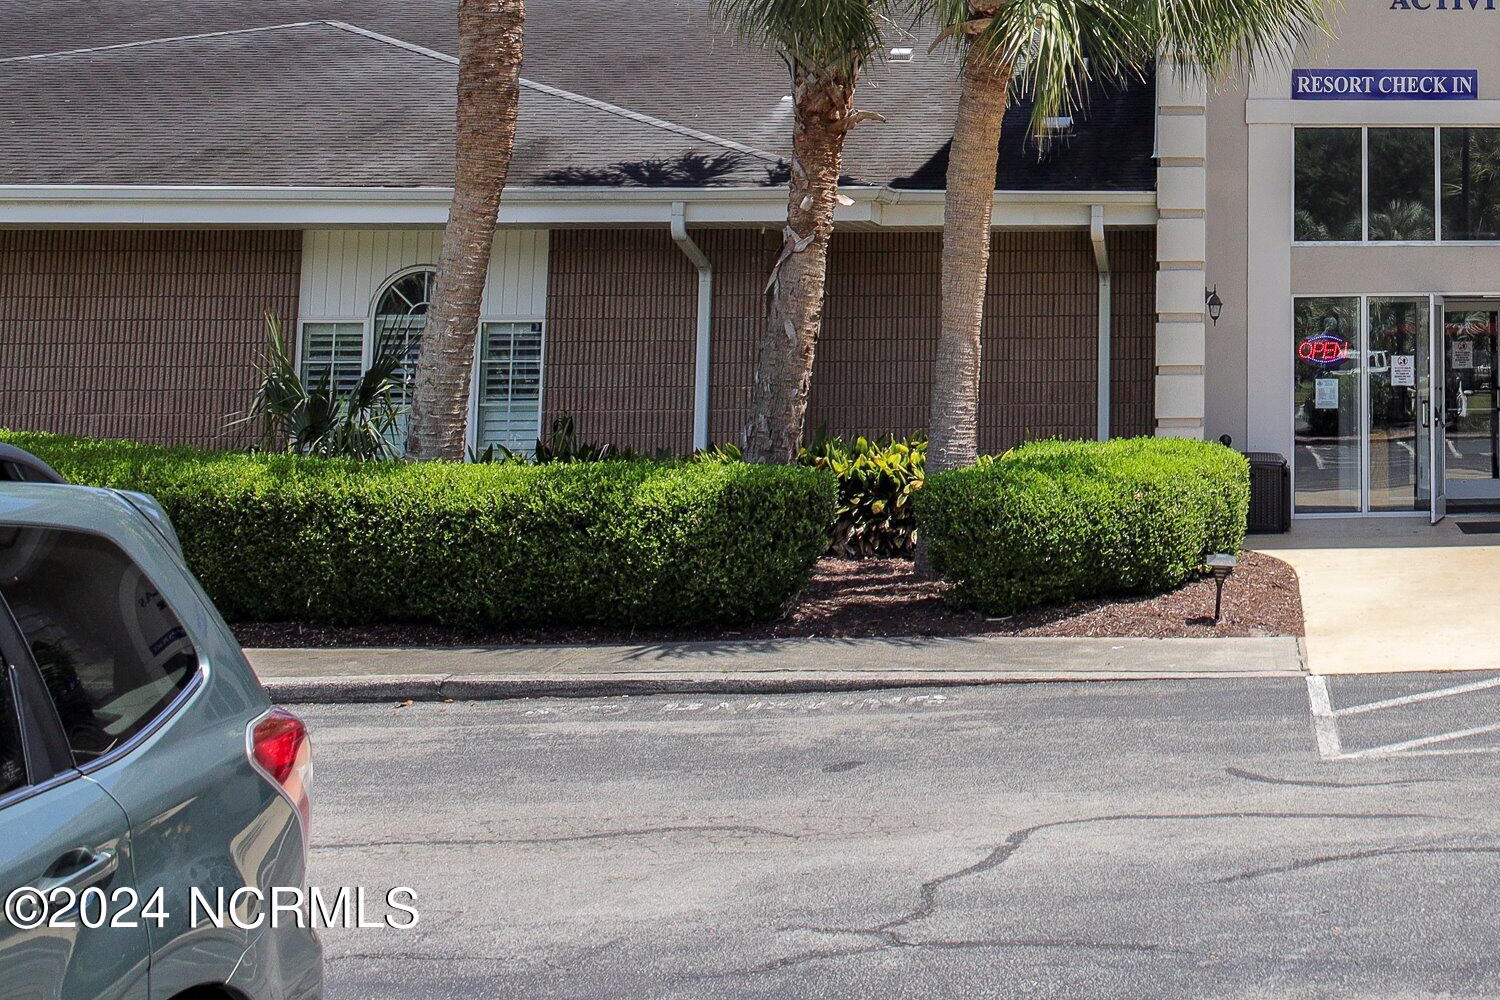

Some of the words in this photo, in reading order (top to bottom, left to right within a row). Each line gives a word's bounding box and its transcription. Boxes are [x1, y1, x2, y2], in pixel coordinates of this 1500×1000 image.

[1297, 76, 1374, 93] RESORT
[1378, 76, 1447, 93] CHECK
[1451, 76, 1472, 93] IN
[1298, 341, 1348, 359] OPEN
